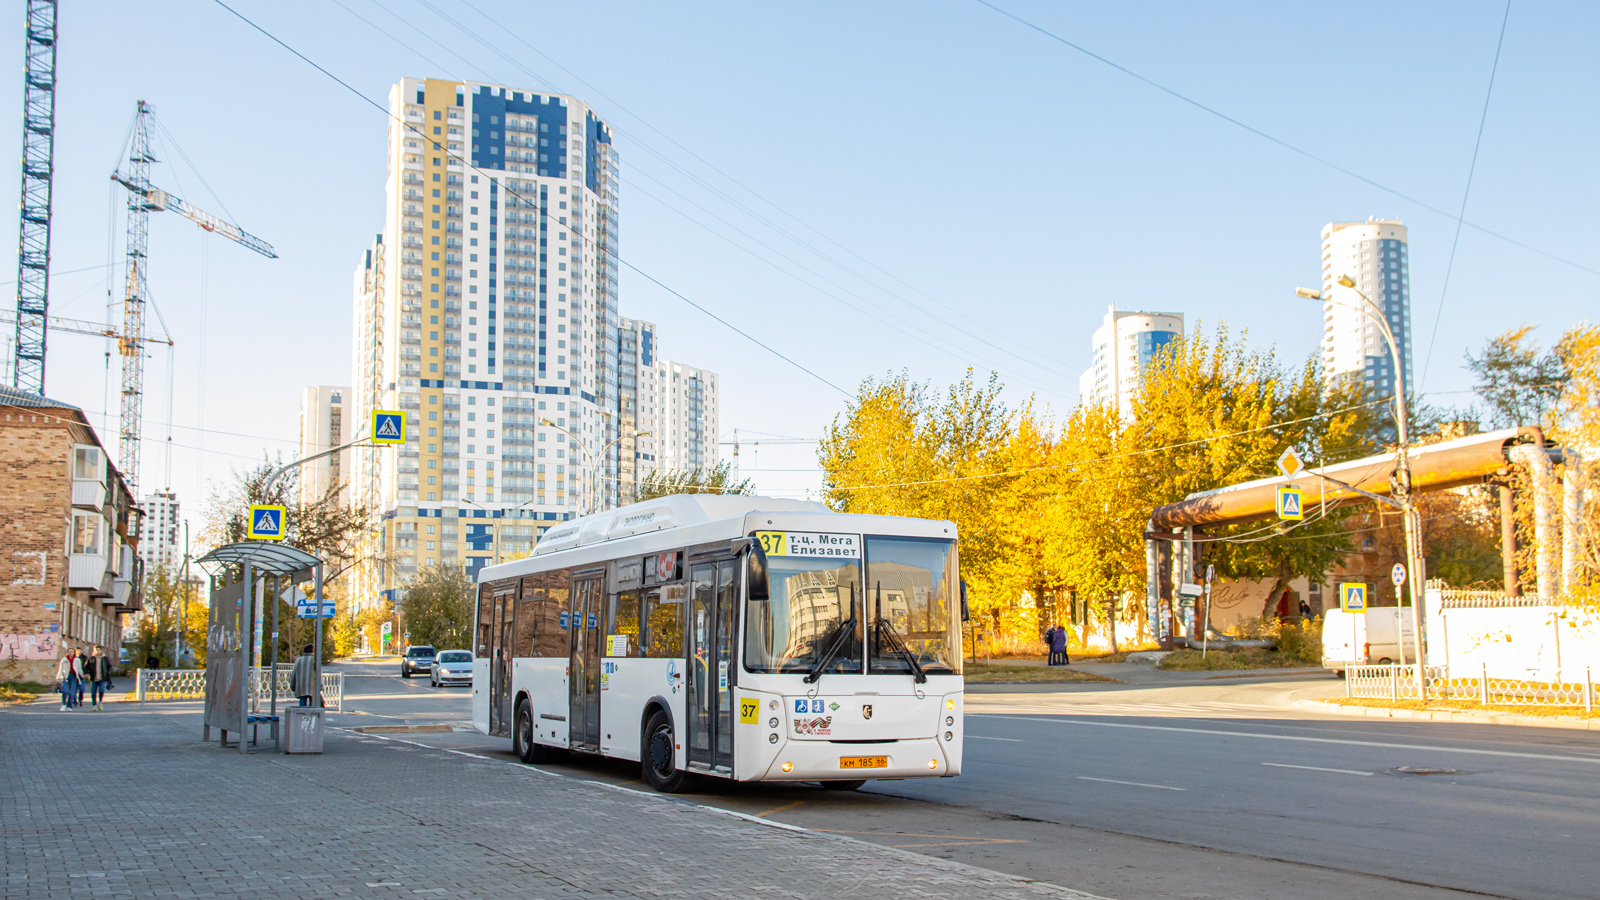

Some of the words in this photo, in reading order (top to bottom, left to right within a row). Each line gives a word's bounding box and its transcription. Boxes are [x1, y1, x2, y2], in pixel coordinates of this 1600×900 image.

[760, 534, 782, 554] 37
[819, 535, 853, 545] Мега
[791, 545, 857, 556] Елизавет
[741, 704, 756, 718] 37
[858, 758, 873, 767] 185
